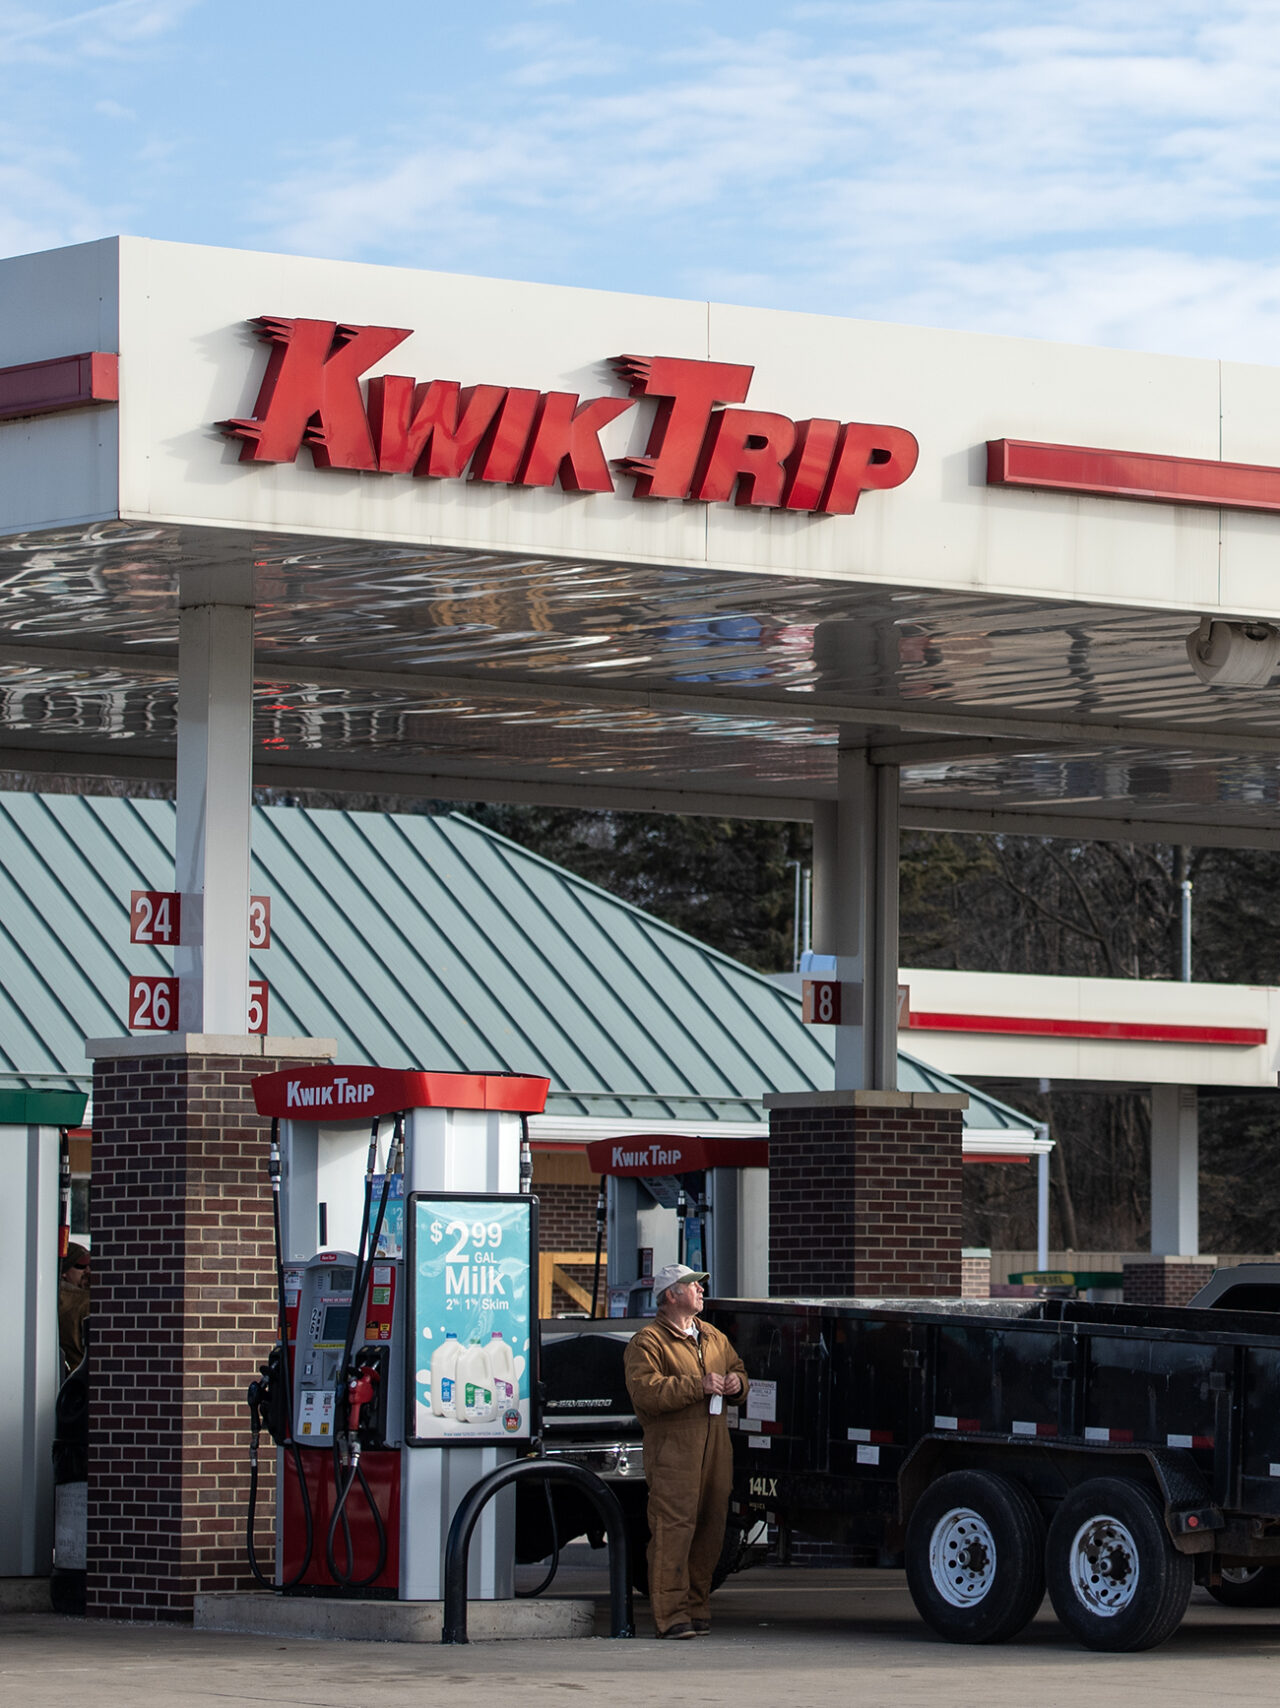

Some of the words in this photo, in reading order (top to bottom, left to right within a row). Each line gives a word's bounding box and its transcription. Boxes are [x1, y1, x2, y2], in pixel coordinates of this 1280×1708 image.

[135, 896, 172, 942] 24
[249, 901, 267, 946] 3
[133, 981, 171, 1028] 26
[248, 986, 263, 1031] 5
[806, 984, 834, 1022] 18
[897, 989, 907, 1025] 7
[474, 1252, 498, 1264] GAL
[445, 1266, 506, 1296] Milk
[481, 1298, 509, 1310] Skim
[749, 1477, 778, 1497] 14LX
